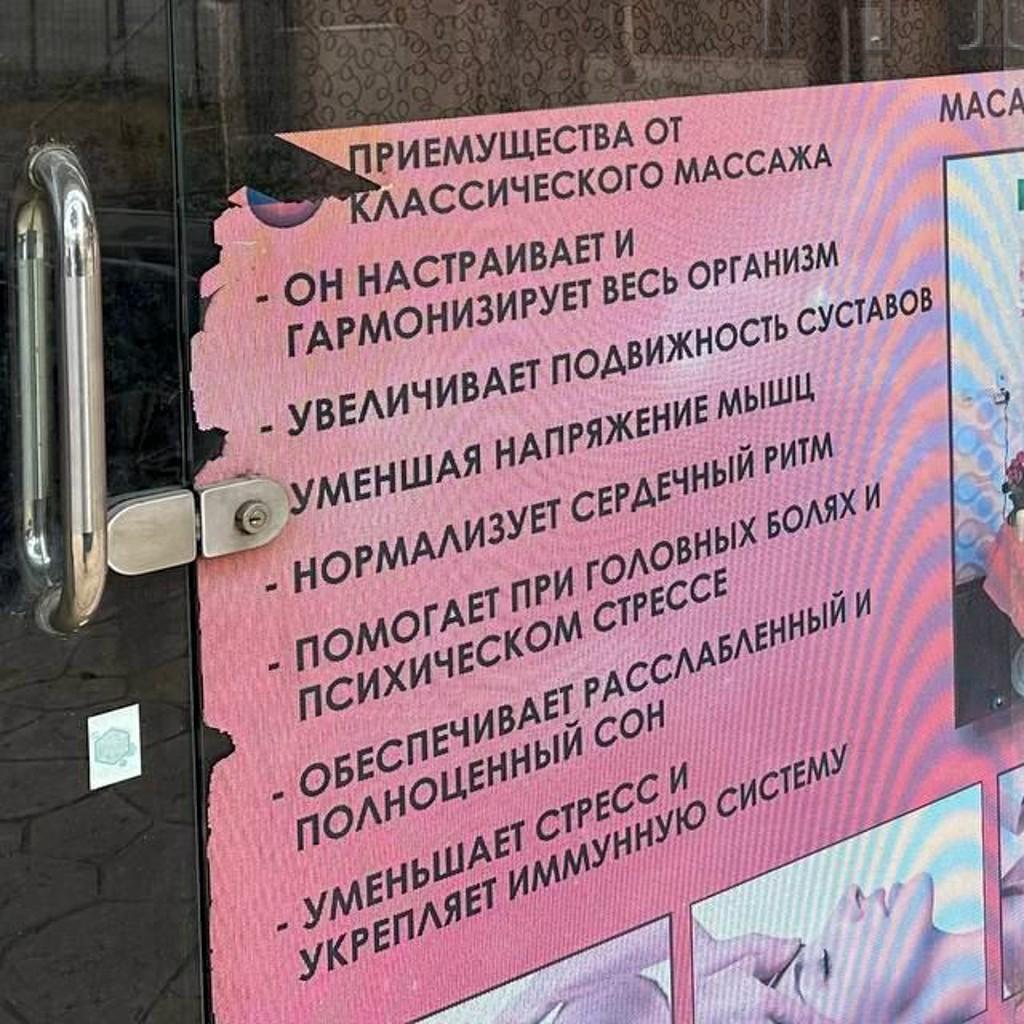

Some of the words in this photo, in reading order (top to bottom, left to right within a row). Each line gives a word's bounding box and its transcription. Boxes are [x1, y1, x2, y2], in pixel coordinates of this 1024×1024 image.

[349, 122, 634, 174] ПРИЕМУЩЕСТВА
[645, 116, 683, 146] ОТ
[350, 164, 664, 223] КЛАССИЧЕСКОГО
[675, 143, 832, 186] МАССАЖА
[284, 268, 343, 306] ОН
[358, 233, 605, 301] НАСТРАИВАЕТ
[616, 229, 634, 259] И
[288, 279, 593, 358] ГАРМОНИЗИРУЕТ
[602, 267, 678, 306] ВЕСЬ
[688, 241, 839, 289] ОРГАНИЗМ
[288, 359, 541, 437] УВЕЛИЧИВАЕТ
[552, 312, 788, 384] ПОДВИЖНОСТЬ
[797, 286, 933, 336] СУСТАВОВ
[290, 443, 482, 515] УМЕНШАЯ
[495, 396, 709, 470] НАПРЯЖЕНИЕ
[718, 372, 815, 418] МЫШЦ
[295, 498, 561, 592] НОРМАЛИЗУЕТ
[571, 444, 756, 523] СЕРДЕЧНЫЙ
[764, 432, 833, 475] РИТМ
[296, 587, 500, 670] ПОМОГАЕТ
[511, 567, 575, 613] ПРИ
[587, 517, 756, 591] ГОЛОВНЫХ
[767, 489, 855, 538] БОЛЯХ
[866, 482, 881, 510] И
[299, 610, 583, 720] ПСИХИЧЕСКОМ
[593, 569, 728, 633] СТРЕССЕ
[299, 684, 577, 796] ОБЕСПЕЧИВАЕТ
[585, 590, 845, 708] РАССЛАБЛЕННЫЙ
[855, 587, 872, 617] И
[296, 718, 584, 851] ПОЛНОЦЕННЫЙ
[594, 701, 666, 747] СОН
[304, 820, 526, 928] УМЕНЬШАЕТ
[536, 773, 660, 841] СТРЕСС
[670, 760, 688, 791] И
[298, 877, 497, 981] УКРЕПЛЯЕТ
[509, 800, 706, 900] ИММУННУЮ
[716, 744, 849, 817] СИСТЕМУ
